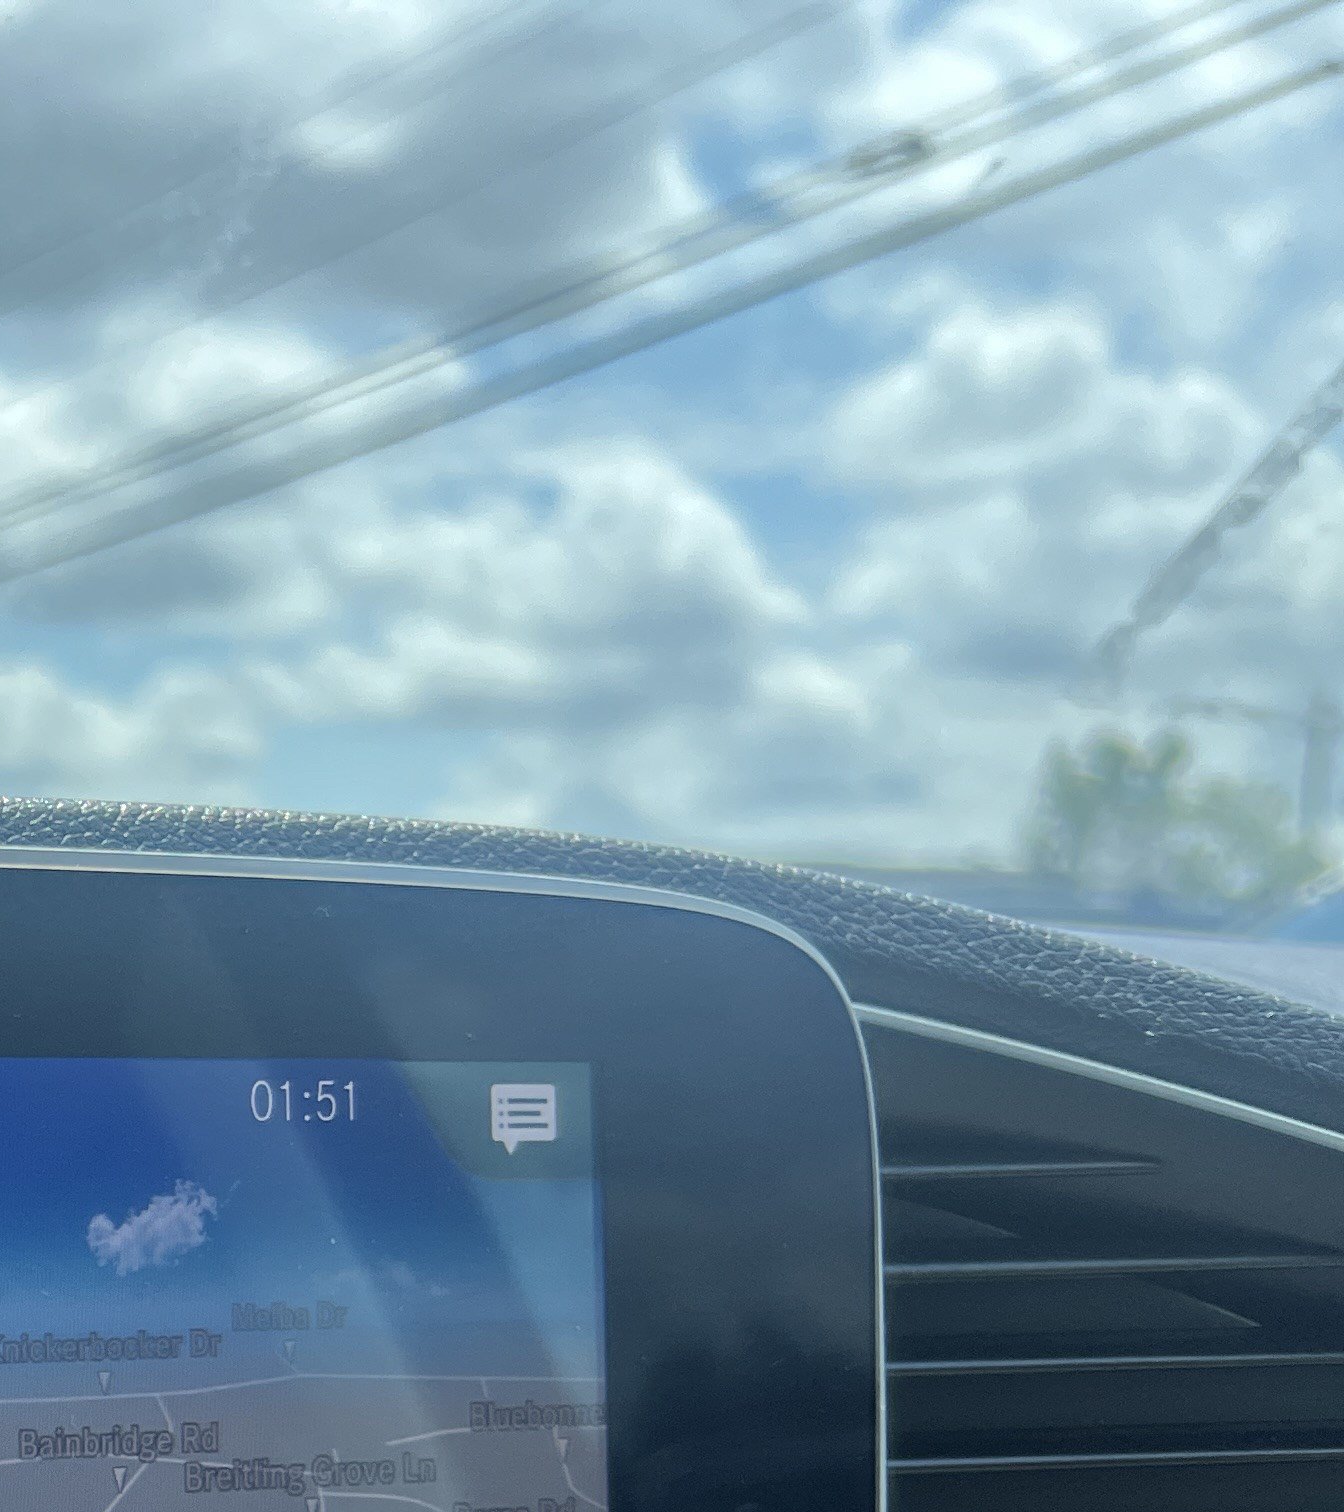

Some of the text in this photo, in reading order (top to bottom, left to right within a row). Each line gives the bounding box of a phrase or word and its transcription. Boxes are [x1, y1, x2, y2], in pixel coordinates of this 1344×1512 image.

[250, 1080, 357, 1122] 01:51
[317, 1301, 350, 1329] Dr
[189, 1329, 223, 1358] Dr
[19, 1421, 219, 1462] Bainbridge Rd
[184, 1452, 436, 1495] Breitling Grove Ln
